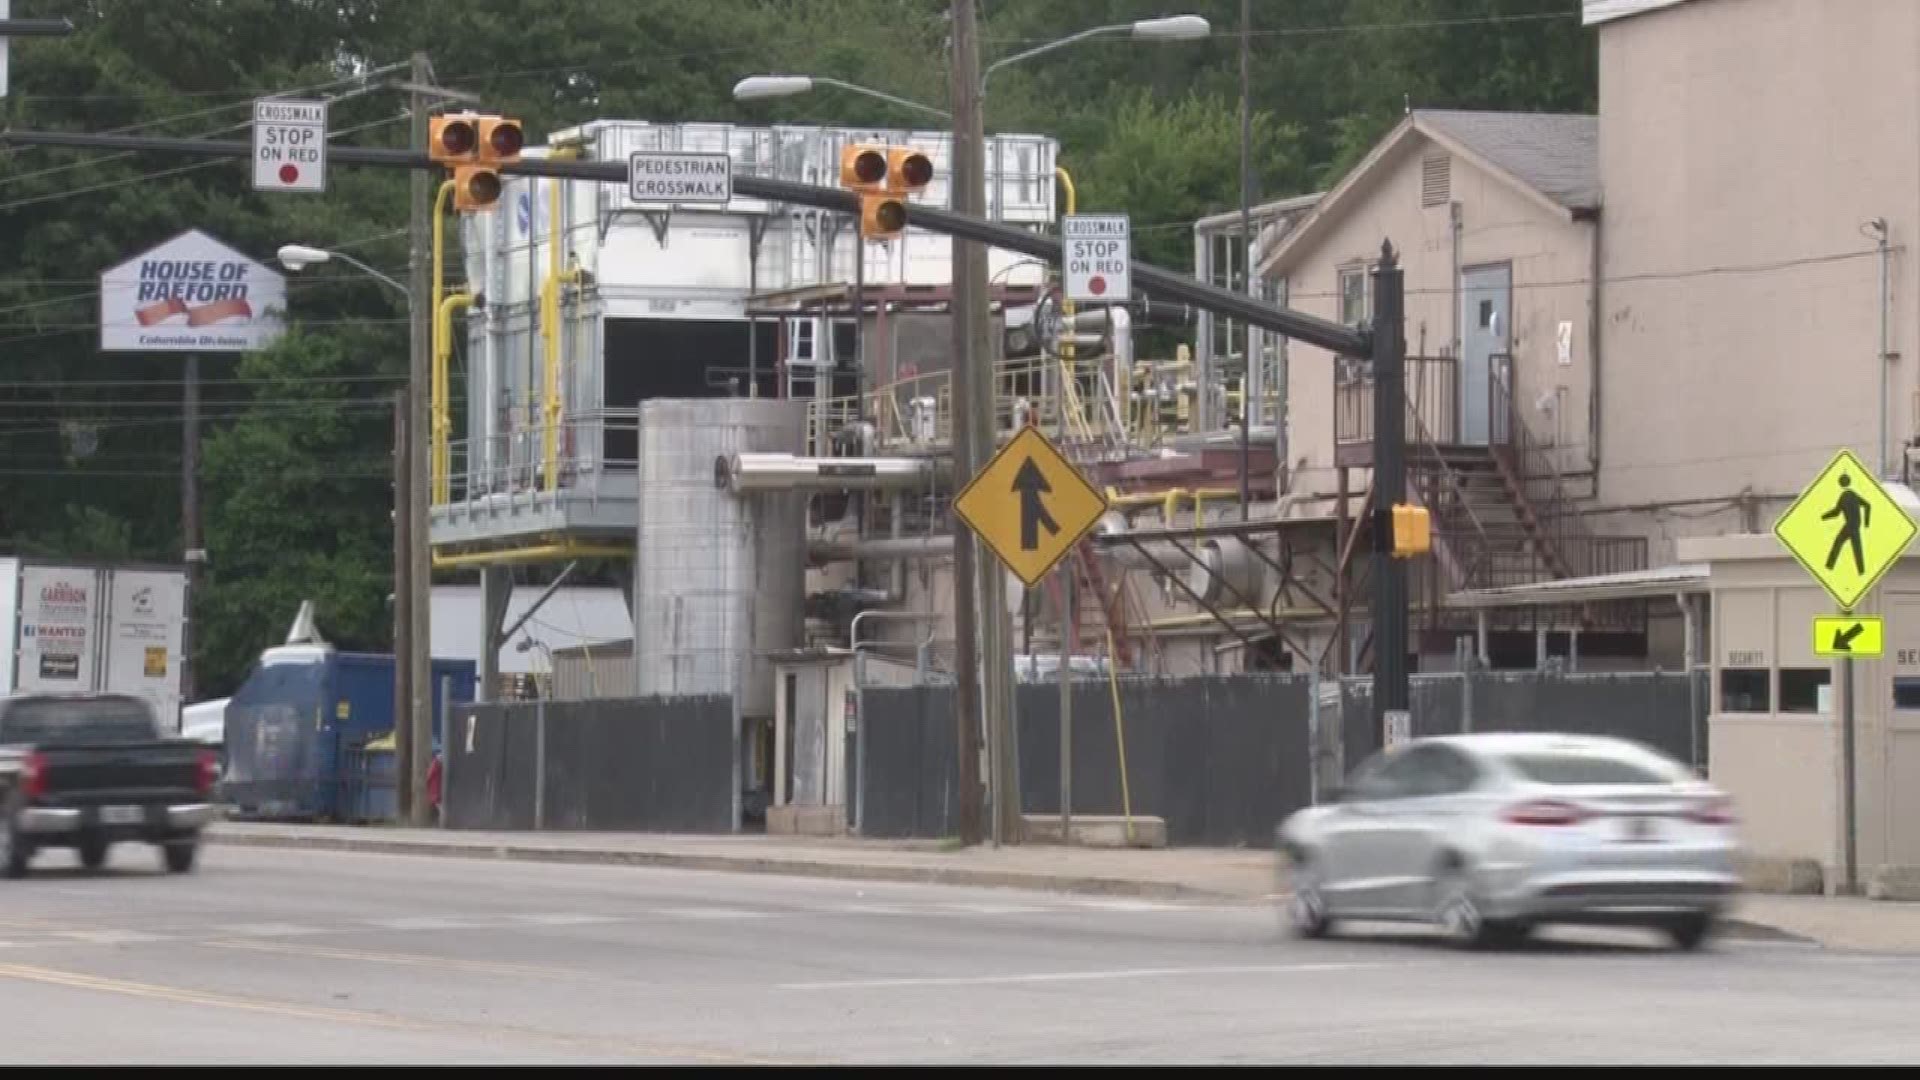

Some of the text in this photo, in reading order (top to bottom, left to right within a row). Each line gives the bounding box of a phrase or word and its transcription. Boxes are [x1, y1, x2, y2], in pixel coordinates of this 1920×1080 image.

[259, 106, 321, 120] CROSSWALK
[266, 127, 314, 145] STOP
[260, 146, 319, 162] ON RED
[636, 160, 725, 174] PEDESTRIAN
[636, 180, 724, 195] CROSSWALK
[1067, 220, 1124, 234] CROSSWALK
[1074, 241, 1119, 257] STOP
[140, 260, 249, 282] HOUSE OF
[1070, 260, 1124, 274] ON RED
[138, 281, 248, 301] RAEFORD
[38, 626, 86, 637] WANTED
